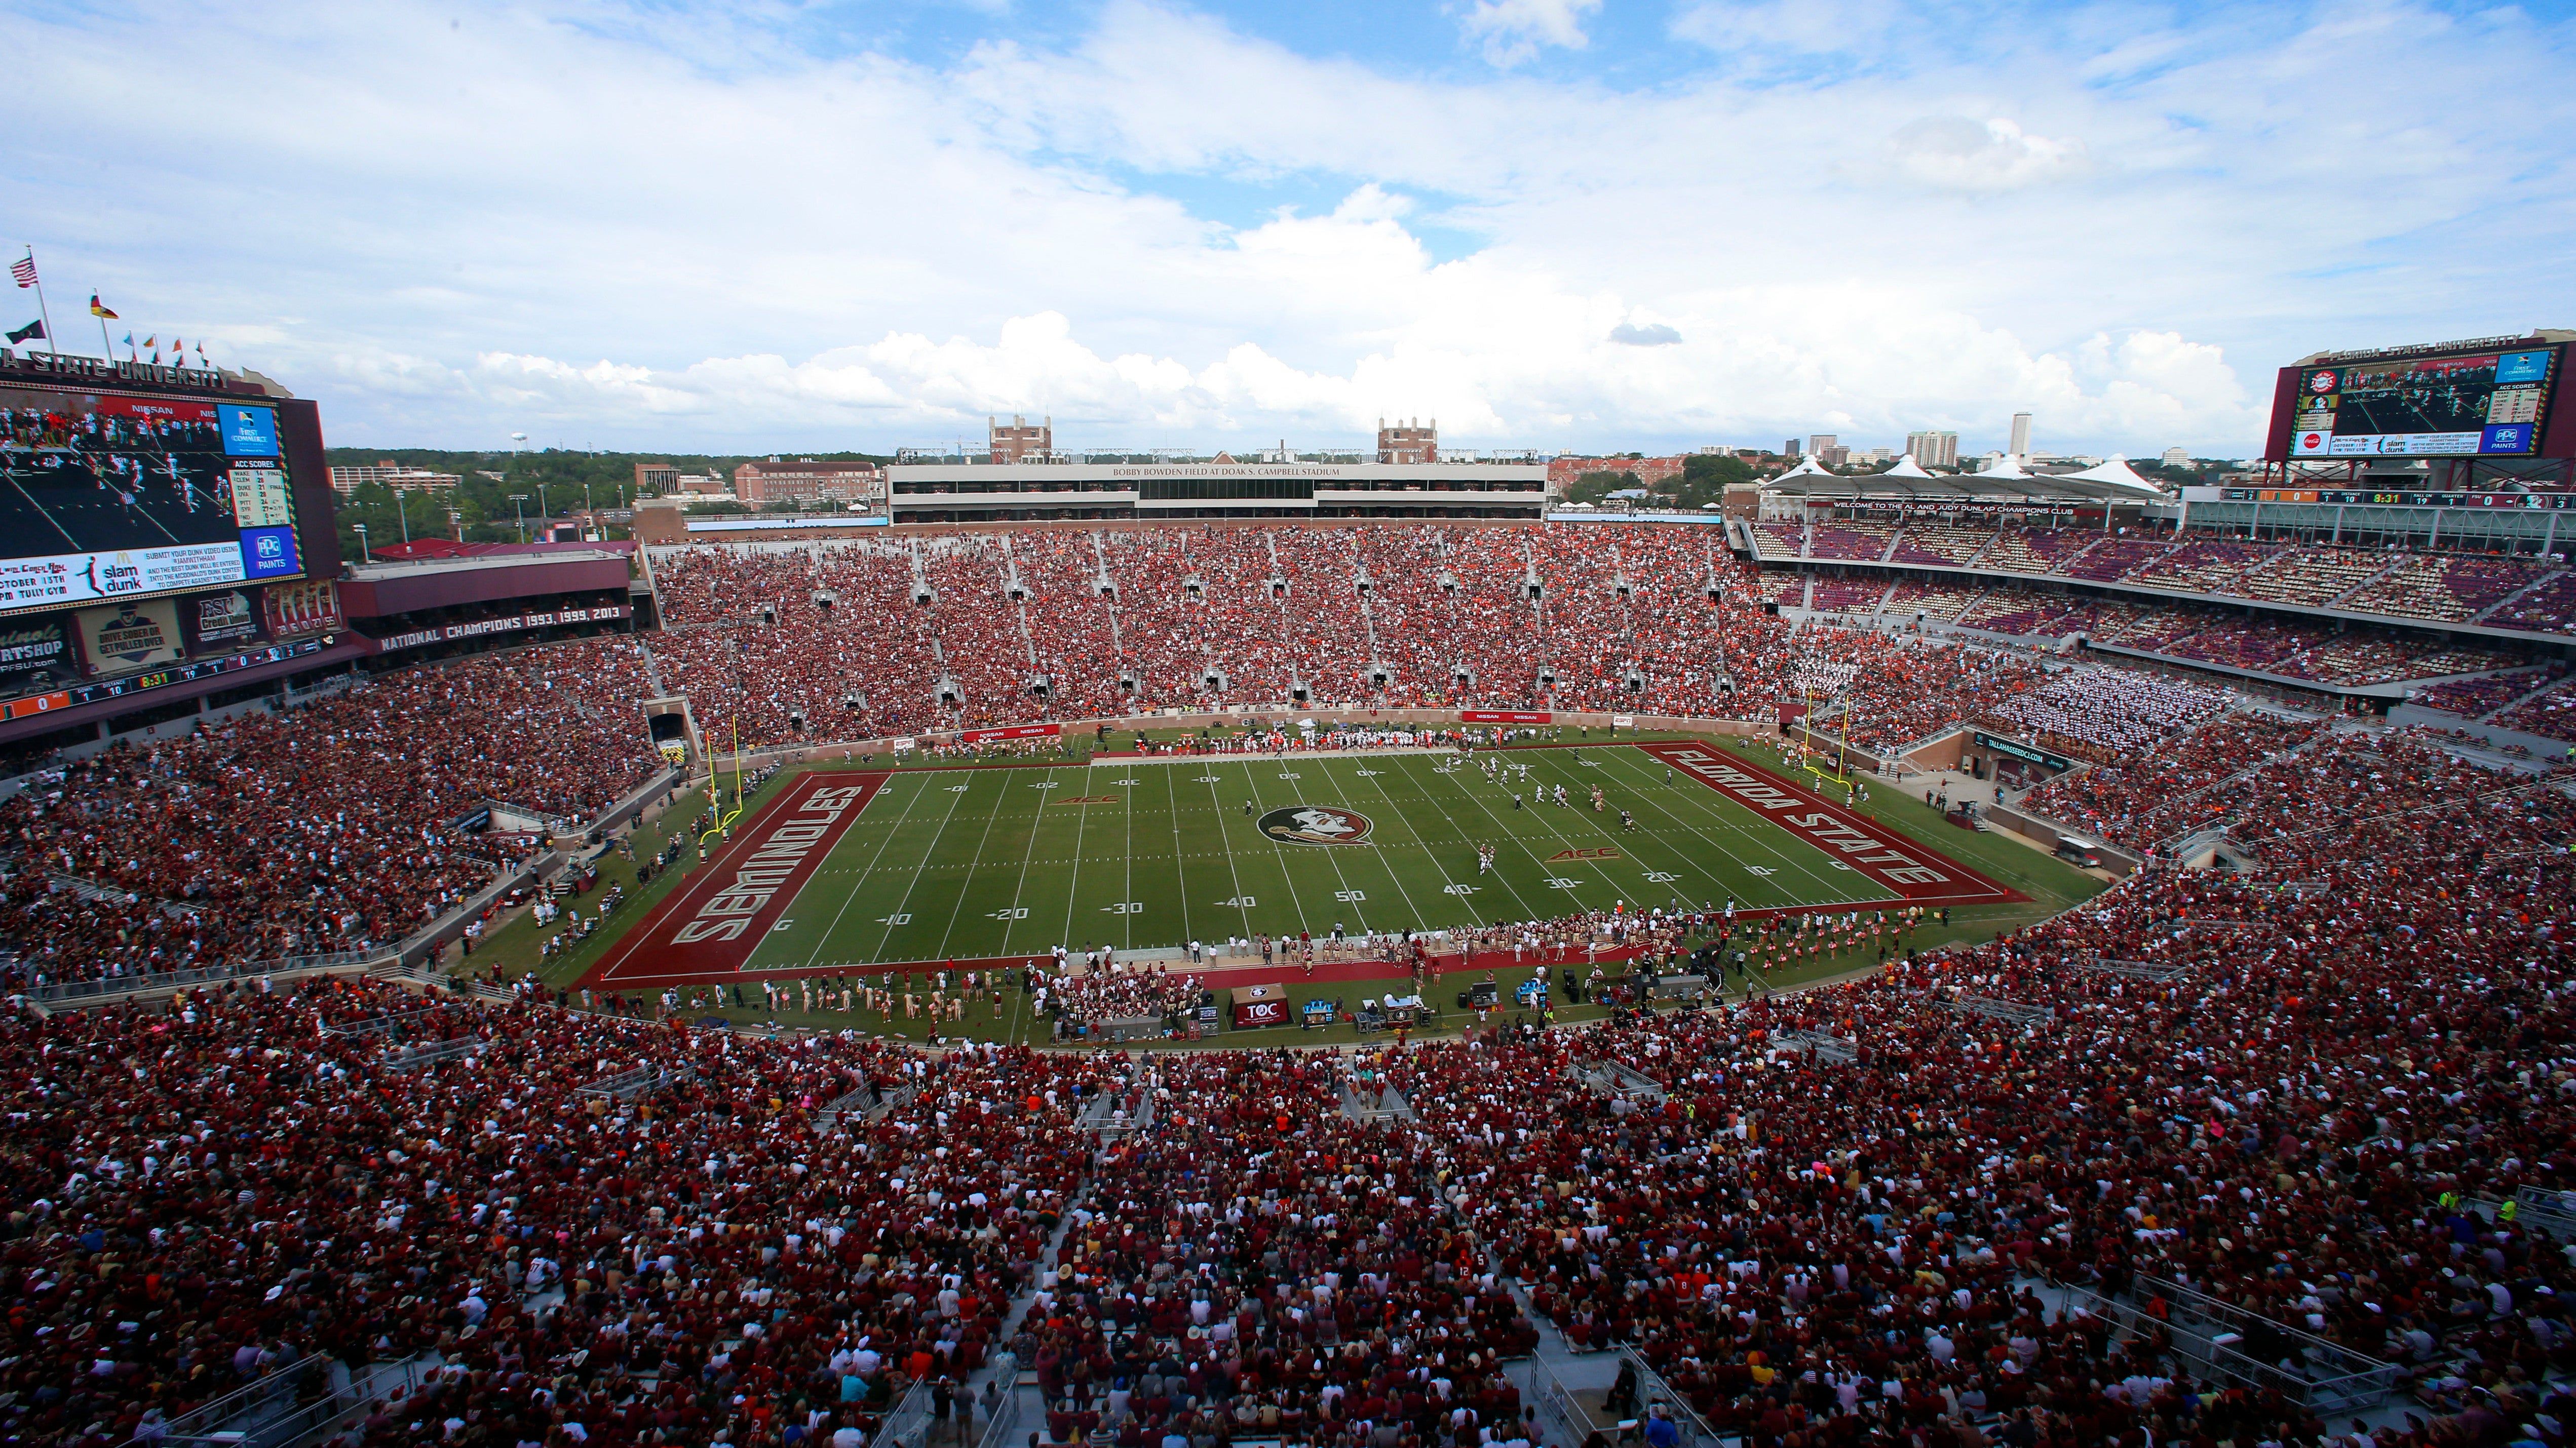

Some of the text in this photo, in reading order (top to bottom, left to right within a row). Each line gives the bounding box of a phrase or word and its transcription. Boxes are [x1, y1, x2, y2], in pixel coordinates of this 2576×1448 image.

[2330, 334, 2523, 361] FLORIDA STATE UNIVERSITY
[27, 350, 228, 388] STATE UNIVERSITY
[239, 427, 258, 436] FIRST
[2498, 430, 2516, 441] PPG
[2293, 492, 2300, 500] 0
[2374, 494, 2400, 503] 8:31
[2484, 496, 2492, 505] 0
[259, 539, 279, 556] PPG
[145, 551, 170, 560] SUBMIT
[258, 559, 286, 570] PAINTS
[104, 565, 138, 578] slam
[175, 571, 207, 579] MCDONALD'S
[107, 577, 142, 592] dunk
[19, 586, 67, 599] TULLY GYM
[200, 597, 235, 618] FSU
[203, 614, 249, 629] Credit Union
[381, 607, 620, 651] NATIONAL CHAMPIONS 1993, 1999, 2013
[100, 627, 161, 644] DRIVE SOBER OR
[100, 636, 166, 654] GET PULLED OVER
[240, 656, 247, 667] 0
[141, 672, 168, 688] 8:31
[184, 670, 196, 679] 19
[102, 680, 126, 689] DISTANCE
[83, 692, 89, 701] 1
[109, 686, 122, 696] 10
[38, 698, 48, 710] 0
[1988, 739, 2043, 763] TALLAHASSEEDCJ.COM
[2048, 760, 2064, 769] Jeep
[1059, 795, 1122, 804] ACC
[1661, 750, 1951, 884] FLORIDA STATE
[1549, 847, 1620, 860] ACC
[669, 785, 863, 946] SEMINOLES
[1743, 865, 1772, 876] 10
[1828, 861, 1852, 871] G
[1543, 877, 1573, 889] 30
[1641, 871, 1675, 883] 20
[1443, 883, 1473, 895] 40
[1225, 896, 1257, 907] 40
[1335, 889, 1367, 902] 50
[996, 908, 1029, 921] 20
[1112, 902, 1143, 915] 30
[773, 919, 794, 931] G
[886, 913, 912, 926] 10
[1247, 1003, 1278, 1019] TOC
